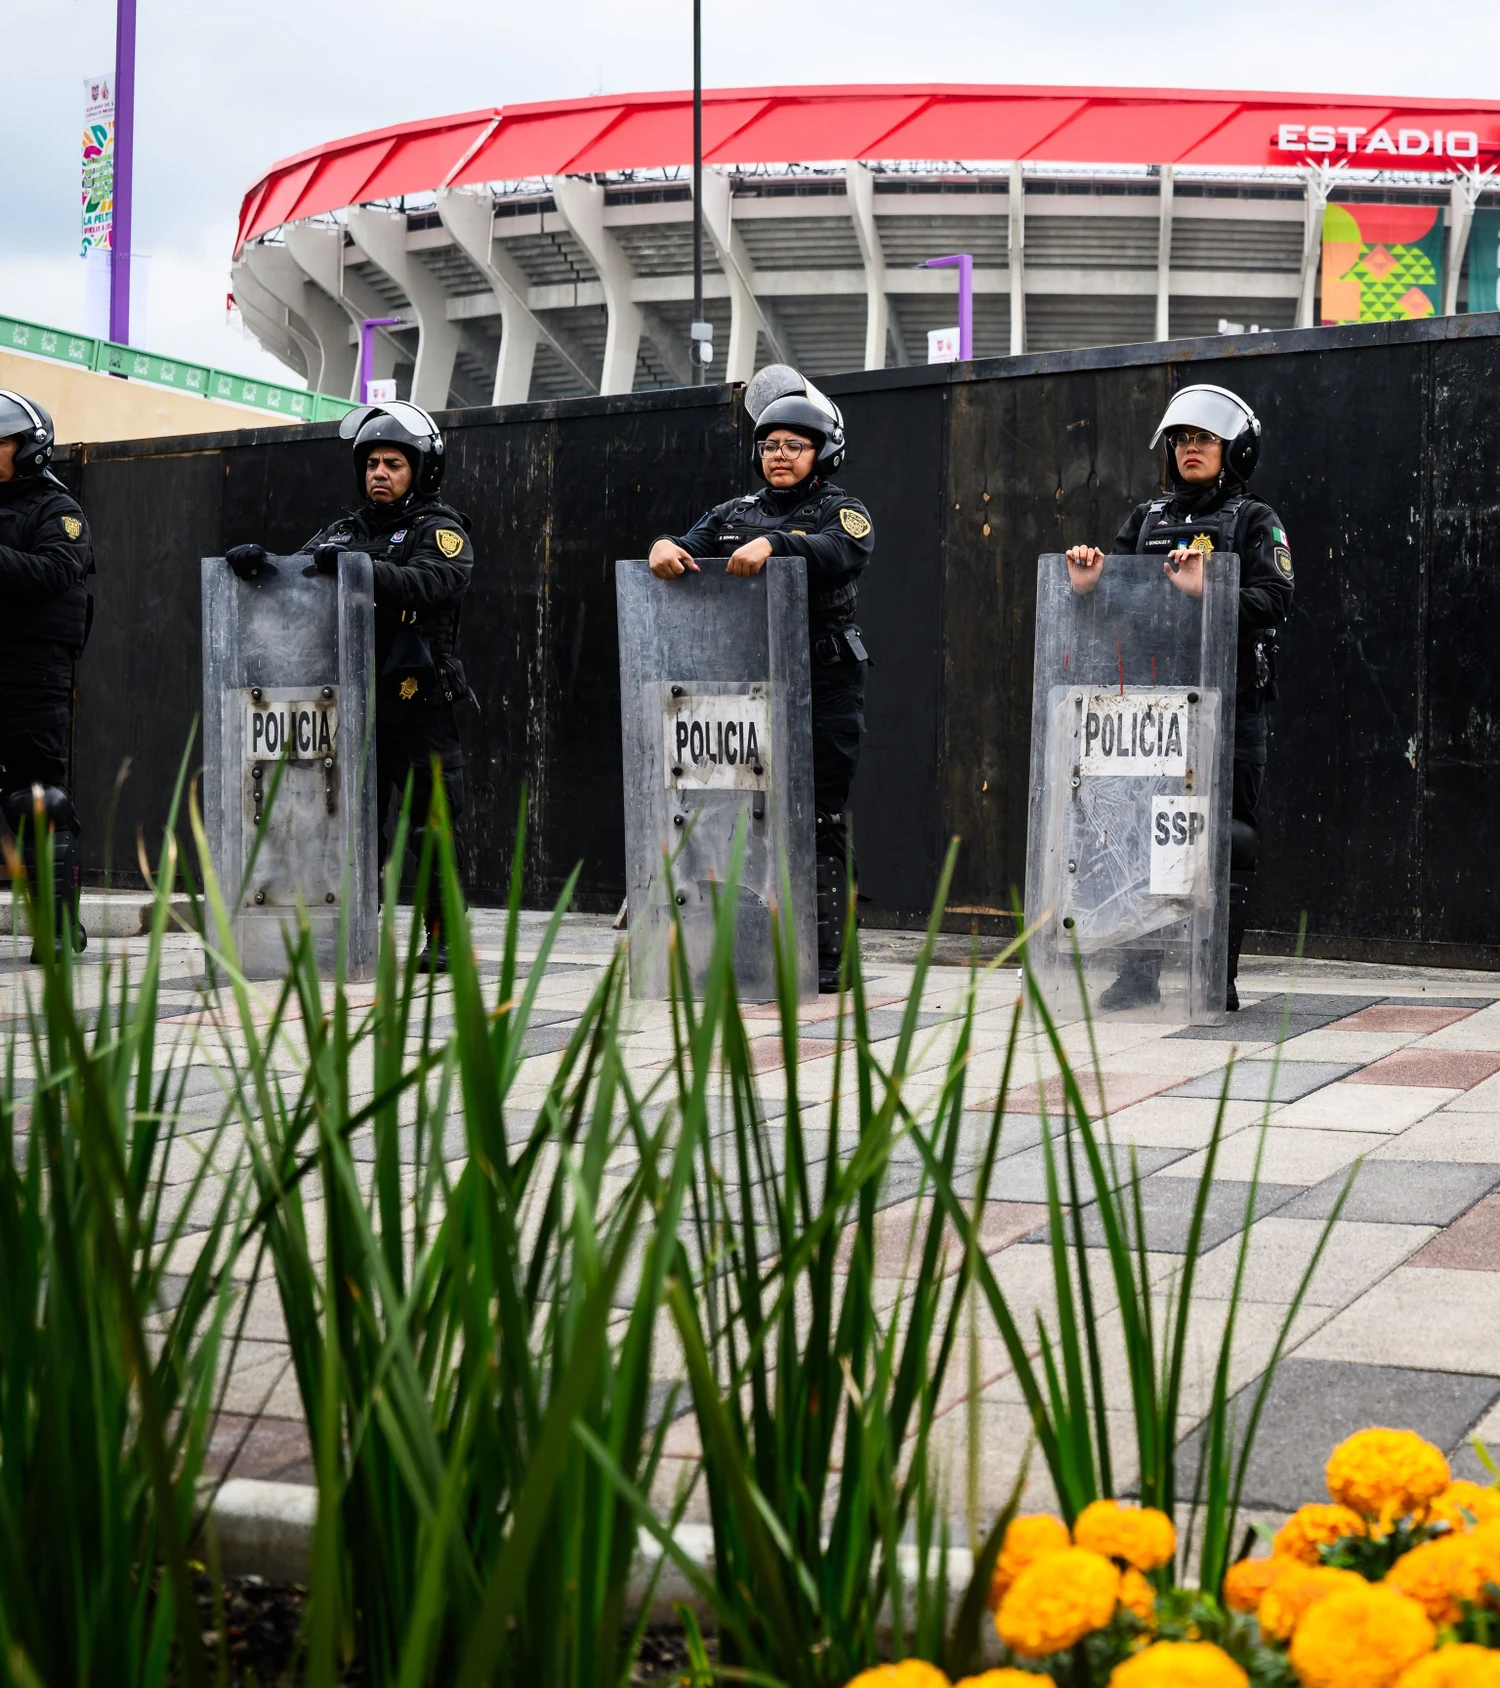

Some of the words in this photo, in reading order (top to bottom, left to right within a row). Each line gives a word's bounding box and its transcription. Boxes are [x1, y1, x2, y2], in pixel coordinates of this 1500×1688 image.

[1278, 124, 1478, 157] ESTADIO
[253, 711, 331, 753] POLICIA
[676, 720, 760, 765] POLICIA
[1085, 712, 1183, 757] POLICIA
[1155, 811, 1205, 846] SSP
